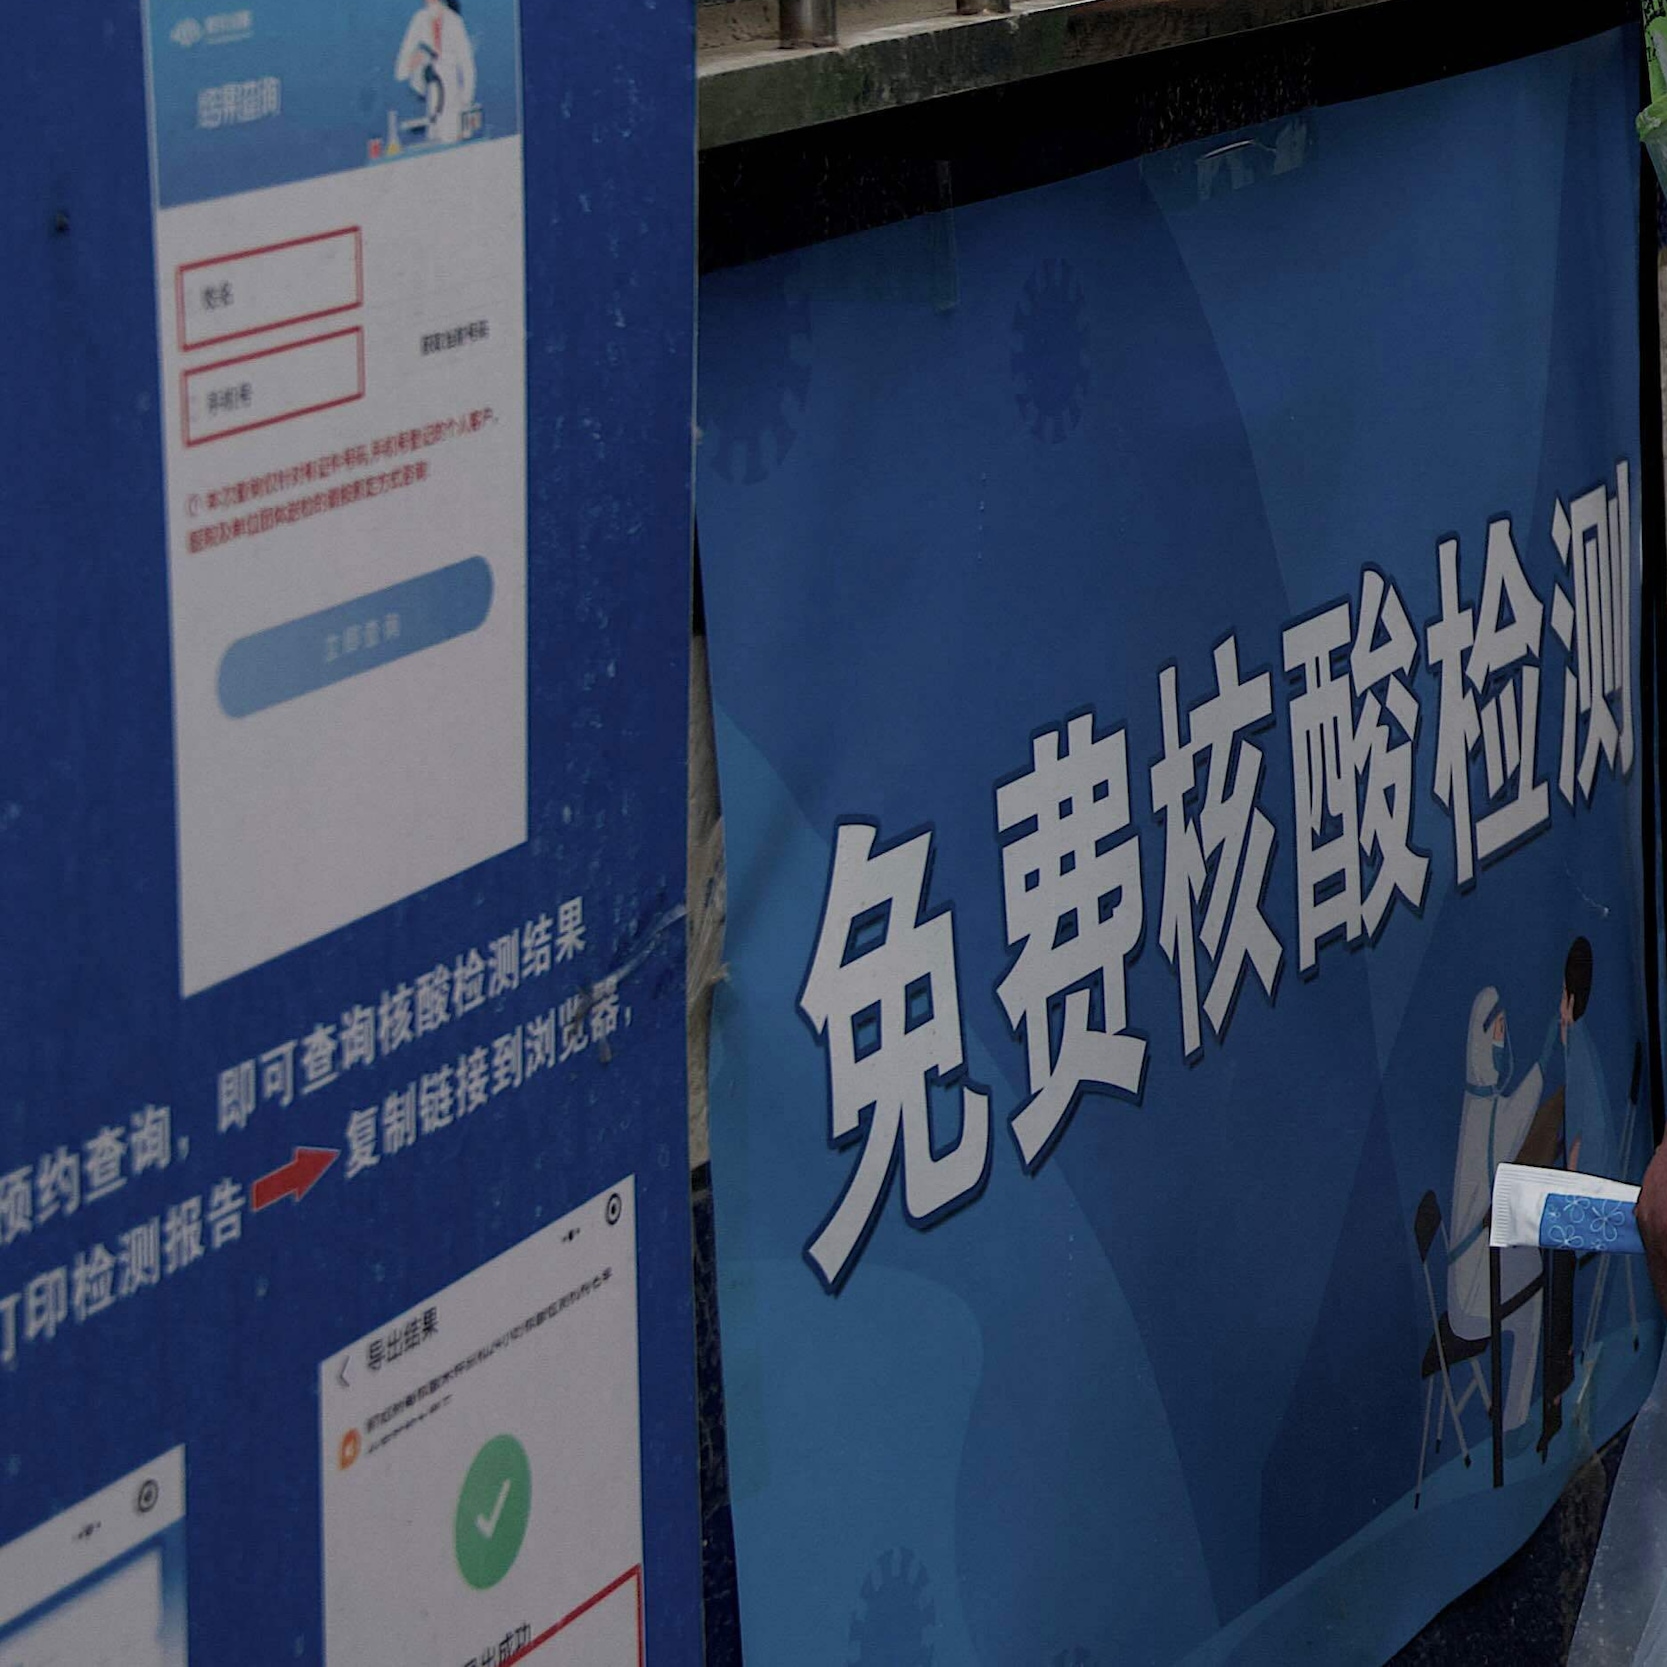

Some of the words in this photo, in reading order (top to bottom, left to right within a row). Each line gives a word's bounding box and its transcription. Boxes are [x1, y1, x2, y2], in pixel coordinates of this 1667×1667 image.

[800, 458, 1634, 1285] 免费核酸检测
